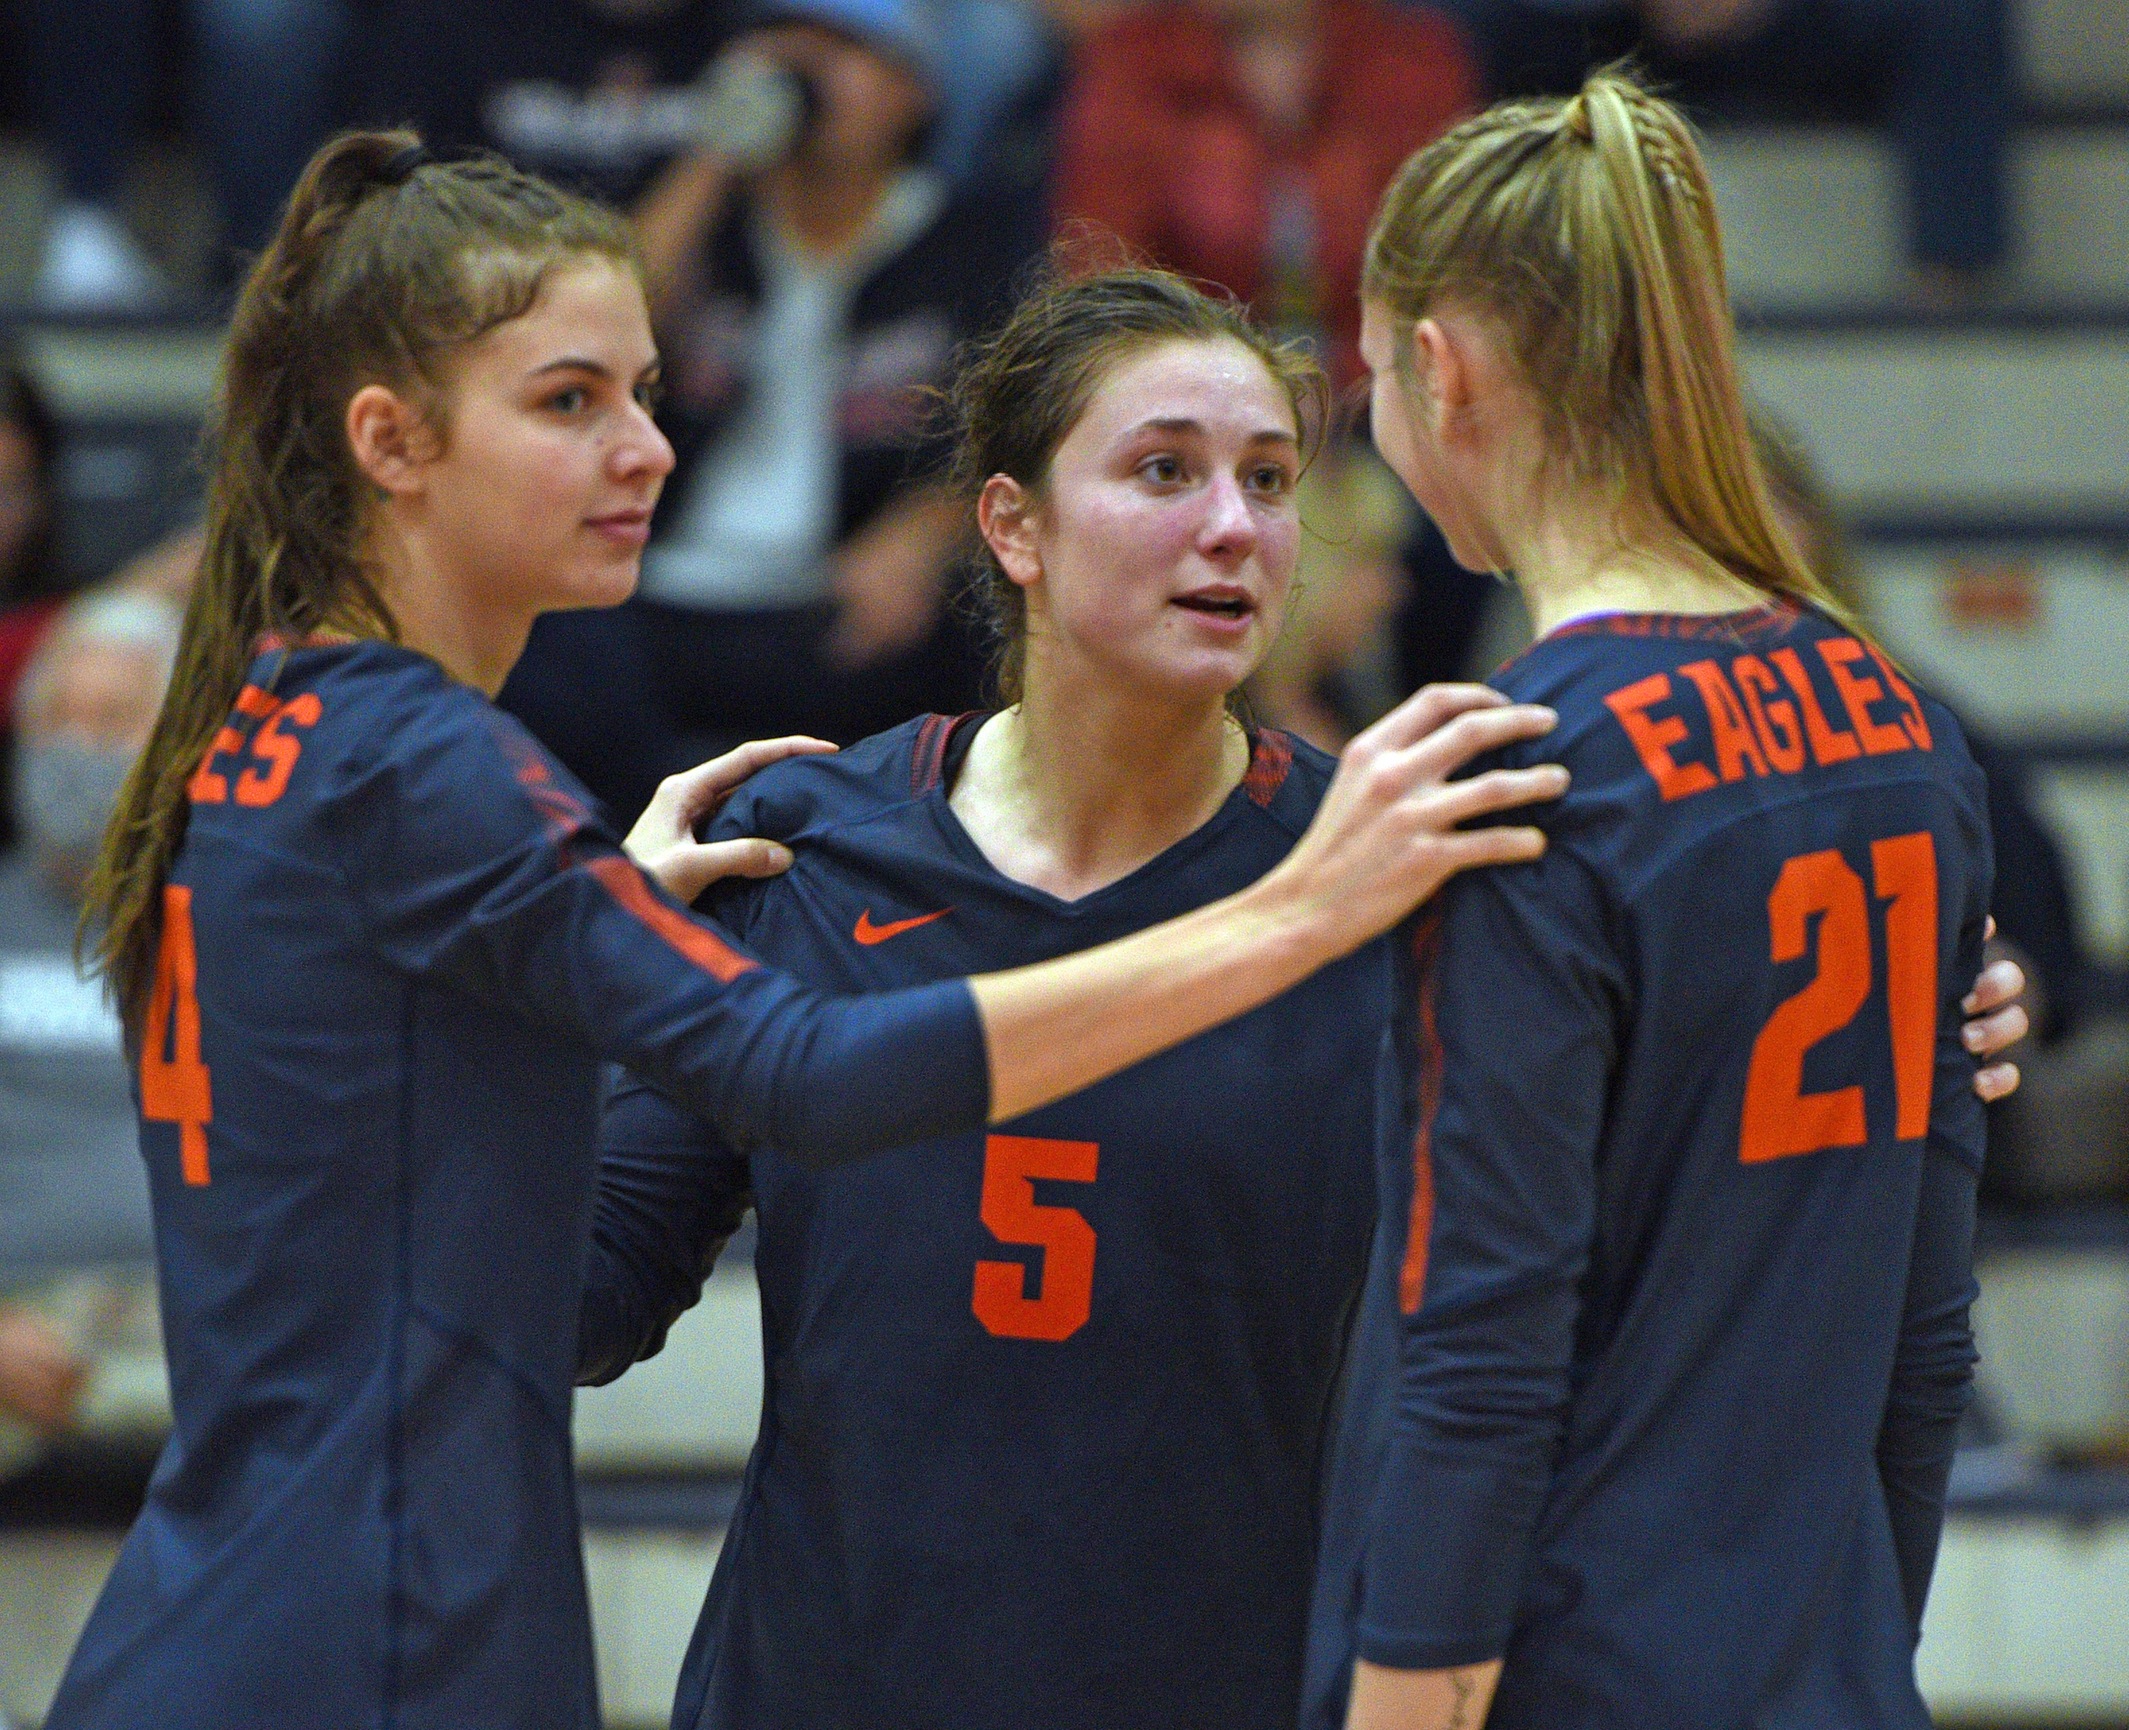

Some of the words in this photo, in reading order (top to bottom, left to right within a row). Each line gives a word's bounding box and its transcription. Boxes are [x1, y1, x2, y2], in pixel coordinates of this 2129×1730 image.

[140, 885, 212, 1186] 4
[1739, 831, 1939, 1165] 21
[971, 1134, 1099, 1342] 5
